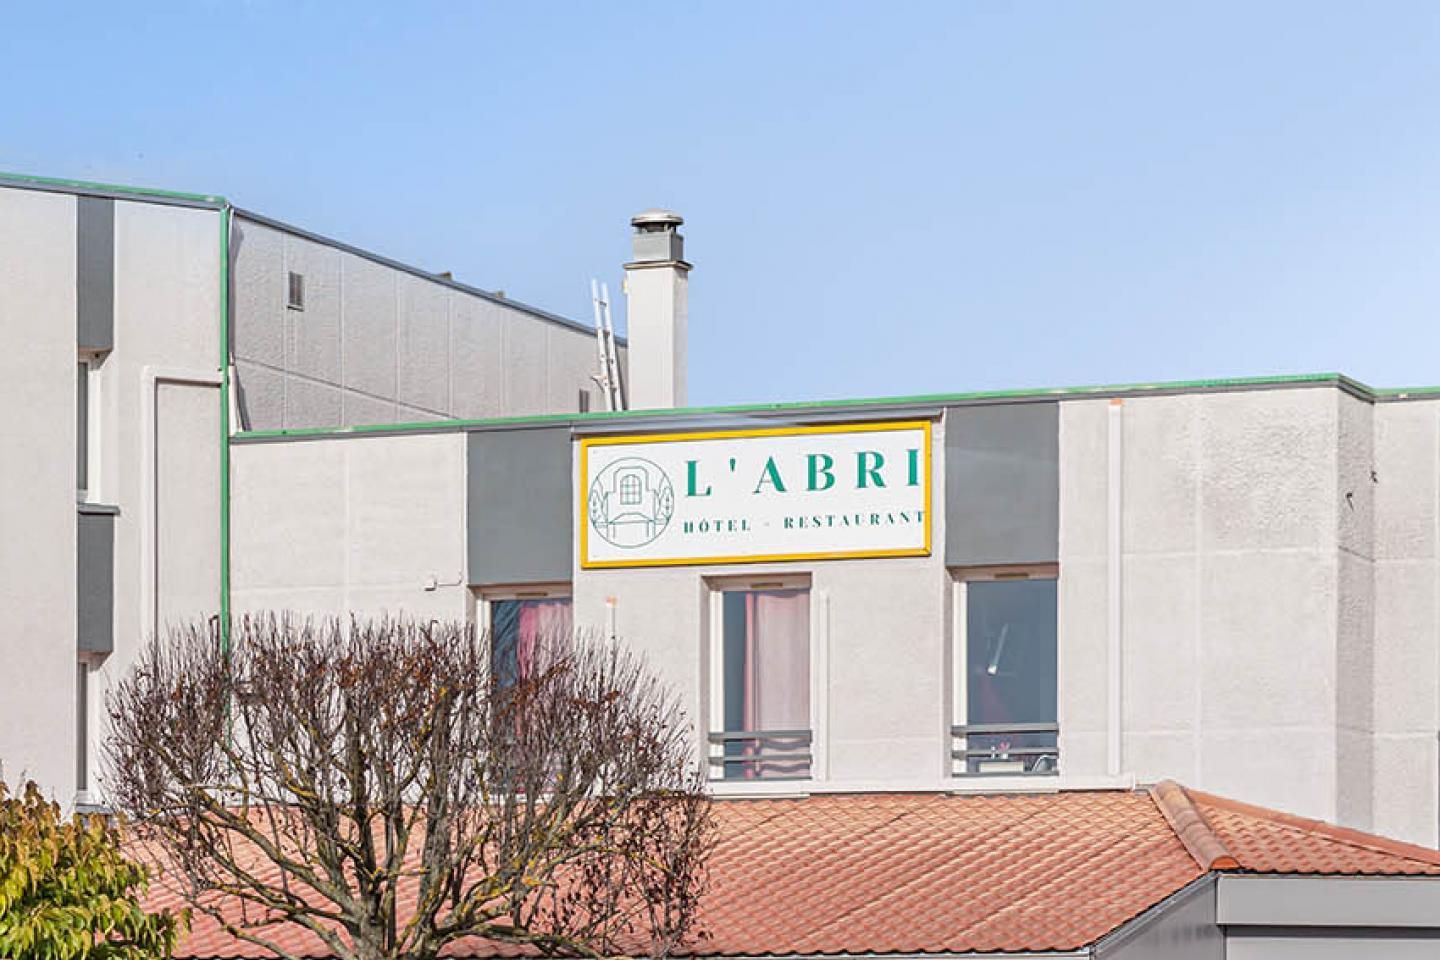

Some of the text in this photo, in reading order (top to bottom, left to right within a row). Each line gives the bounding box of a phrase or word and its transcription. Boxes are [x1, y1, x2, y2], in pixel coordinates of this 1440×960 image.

[685, 448, 919, 498] L'ABRI
[683, 518, 751, 533] HÔTEL
[783, 511, 924, 529] RESTAURANT
